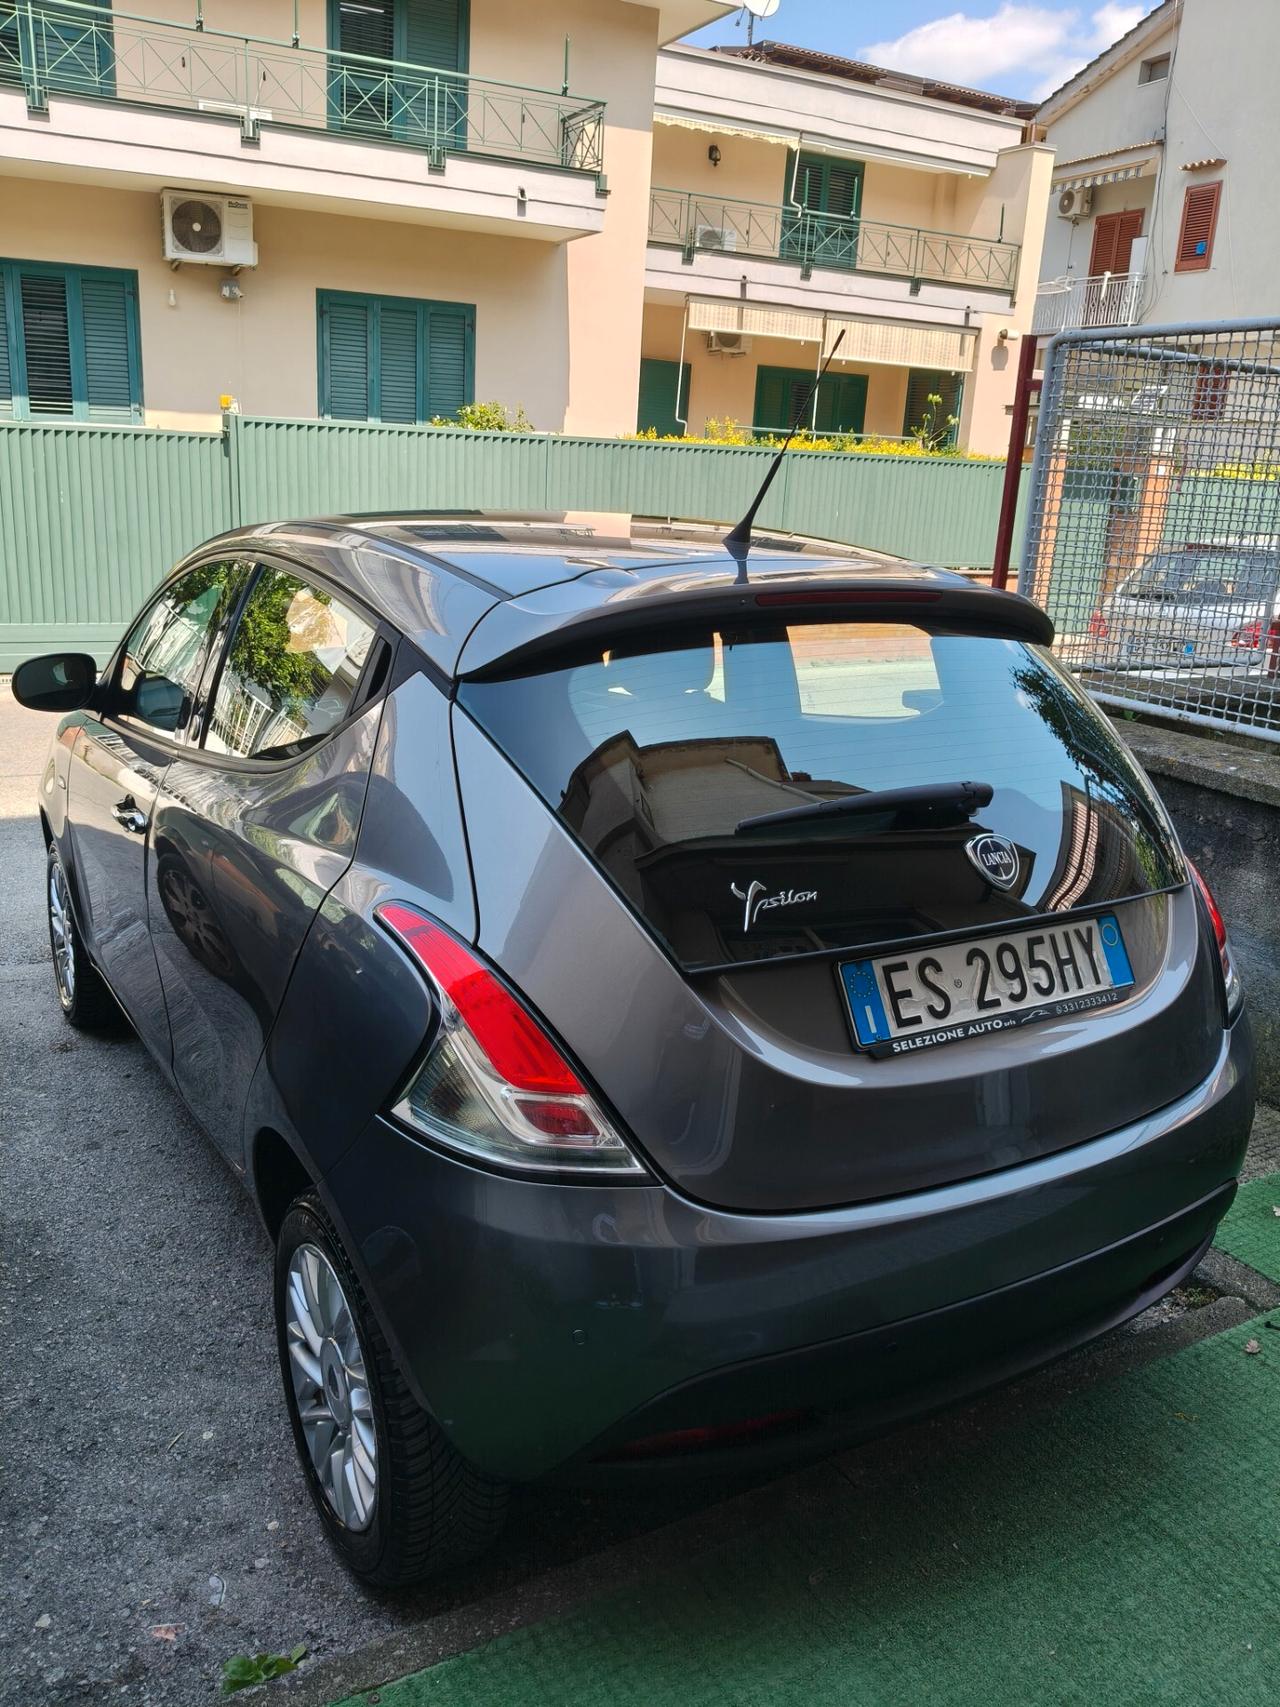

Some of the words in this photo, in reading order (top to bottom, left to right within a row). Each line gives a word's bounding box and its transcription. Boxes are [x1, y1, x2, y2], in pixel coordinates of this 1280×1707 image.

[982, 851, 1012, 866] LANCIA
[731, 880, 817, 932] Ypsilon
[881, 956, 952, 1029] ES
[965, 925, 1102, 1013] 295HY
[892, 1027, 965, 1053] SELEZIONE
[968, 1019, 1003, 1035] AUTO
